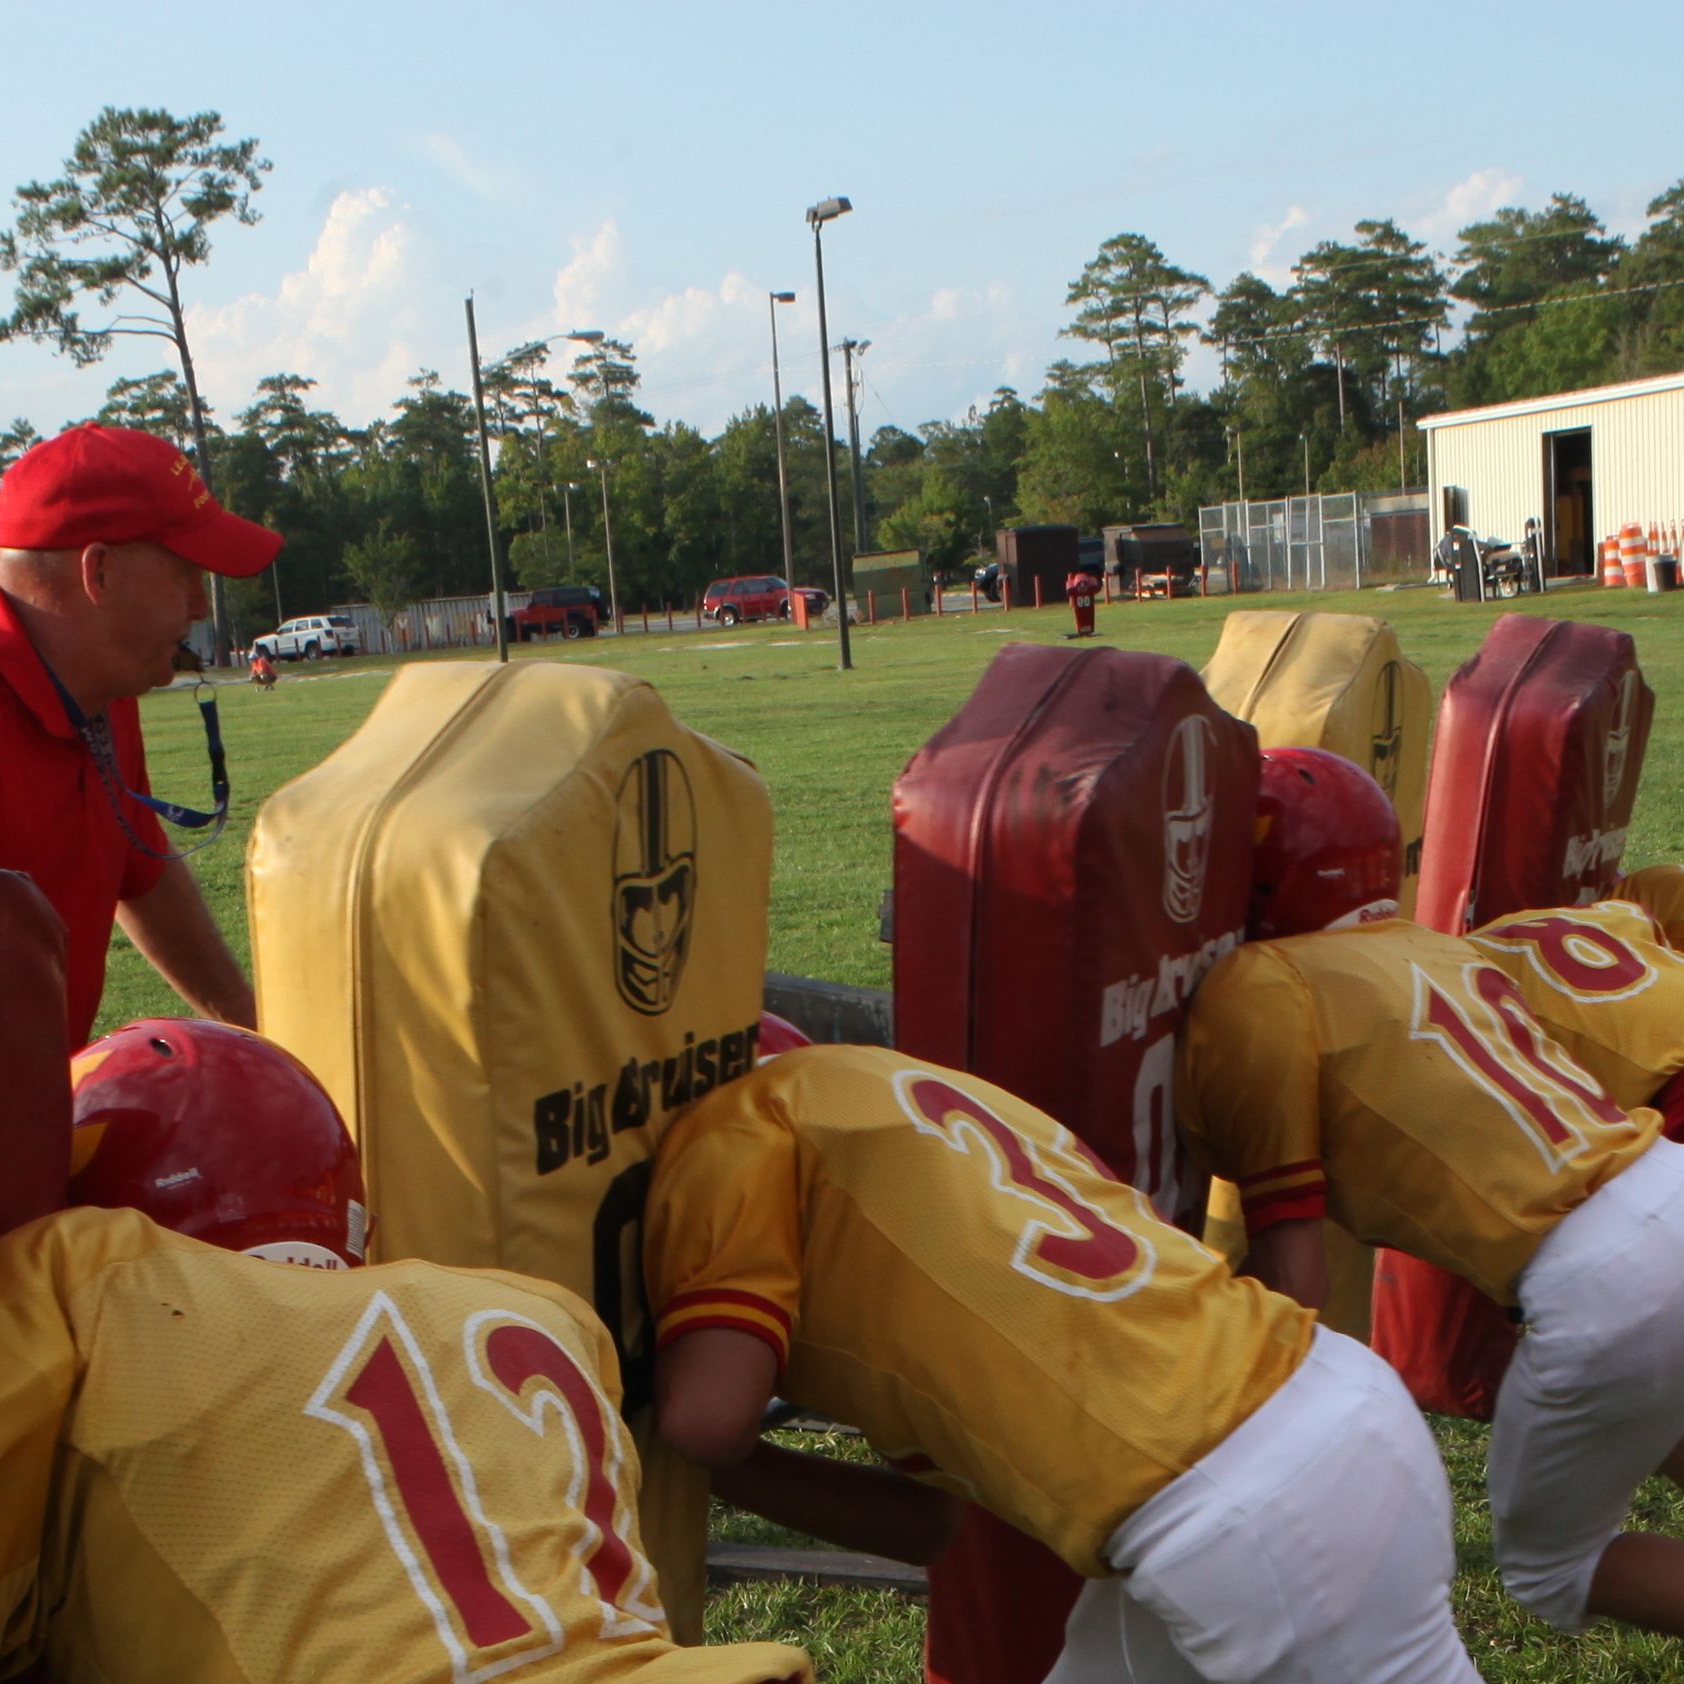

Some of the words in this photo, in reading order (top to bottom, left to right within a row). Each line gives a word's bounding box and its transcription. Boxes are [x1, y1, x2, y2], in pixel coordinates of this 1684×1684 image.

[1100, 974, 1155, 1047] Big
[534, 1080, 611, 1176] Big
[612, 1022, 759, 1136] Bruiser
